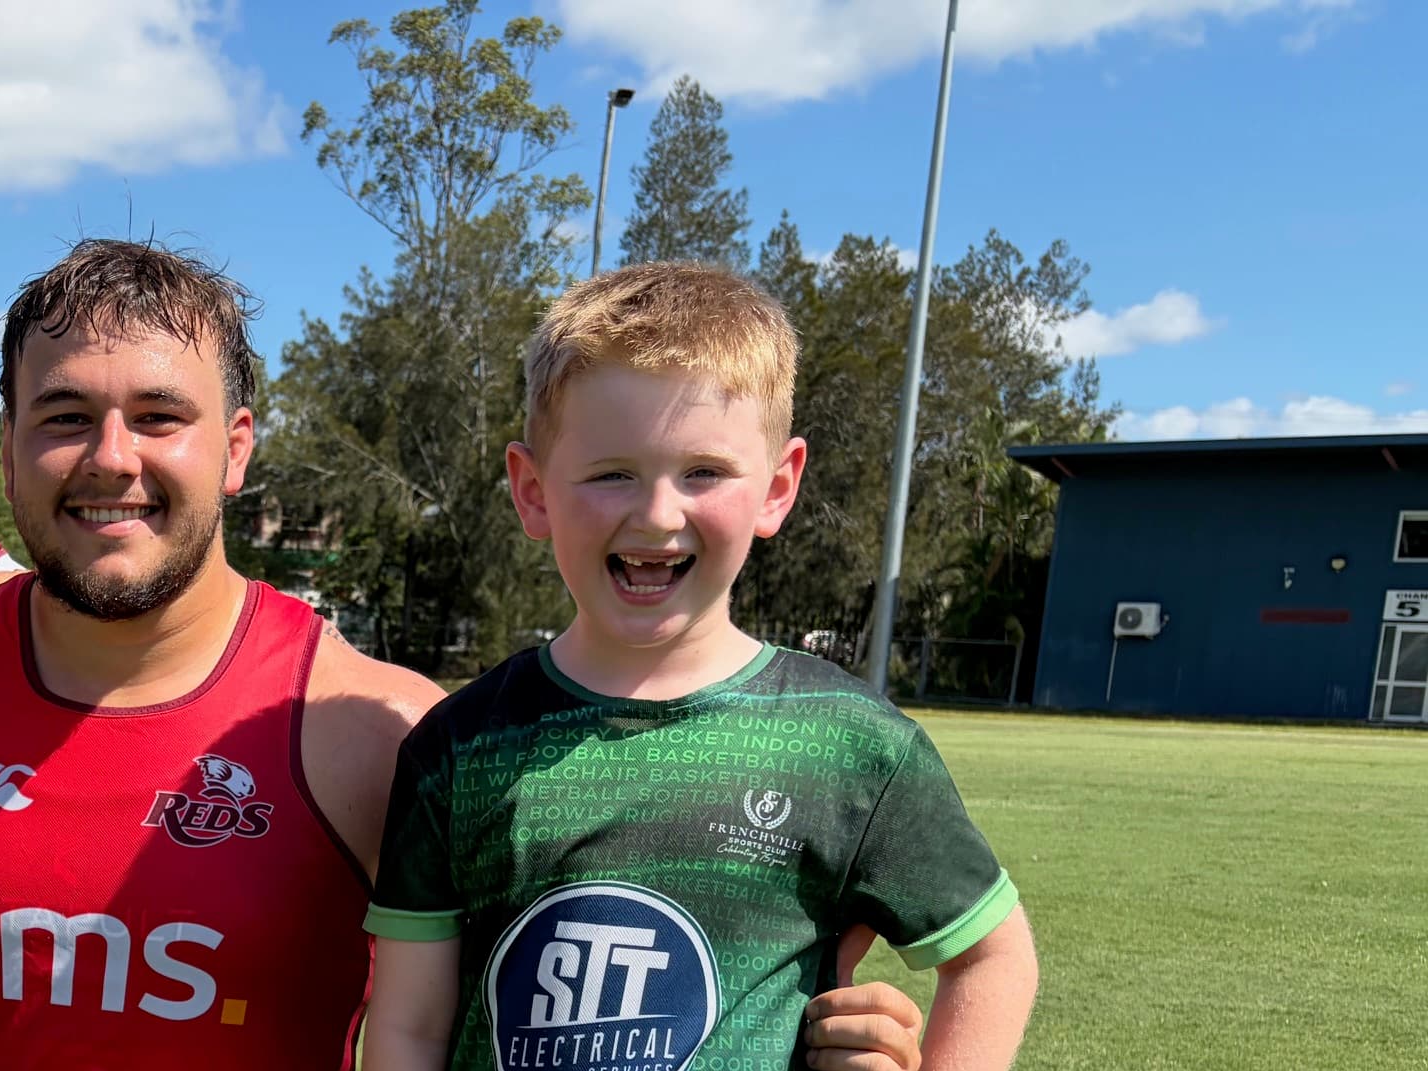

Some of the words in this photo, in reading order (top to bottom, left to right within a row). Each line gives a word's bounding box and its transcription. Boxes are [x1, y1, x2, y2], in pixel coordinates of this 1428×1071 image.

[738, 716, 817, 735] UNION
[456, 753, 506, 771] BALL
[516, 745, 637, 766] FOOTBALL
[646, 748, 804, 776] BASKETBALL
[743, 735, 836, 763] INDOOR
[488, 764, 641, 787] WHEELCHAIR
[650, 767, 804, 799] BASKETBALL
[521, 785, 628, 801] NETBALL
[141, 790, 274, 848] REDS
[529, 805, 614, 820] BOWLS
[708, 822, 805, 852] FRENCHVILLE
[728, 837, 763, 850] SPORTS
[765, 845, 787, 856] CLUB
[530, 920, 671, 1028] STT
[508, 1028, 676, 1068] ELECTRICAL
